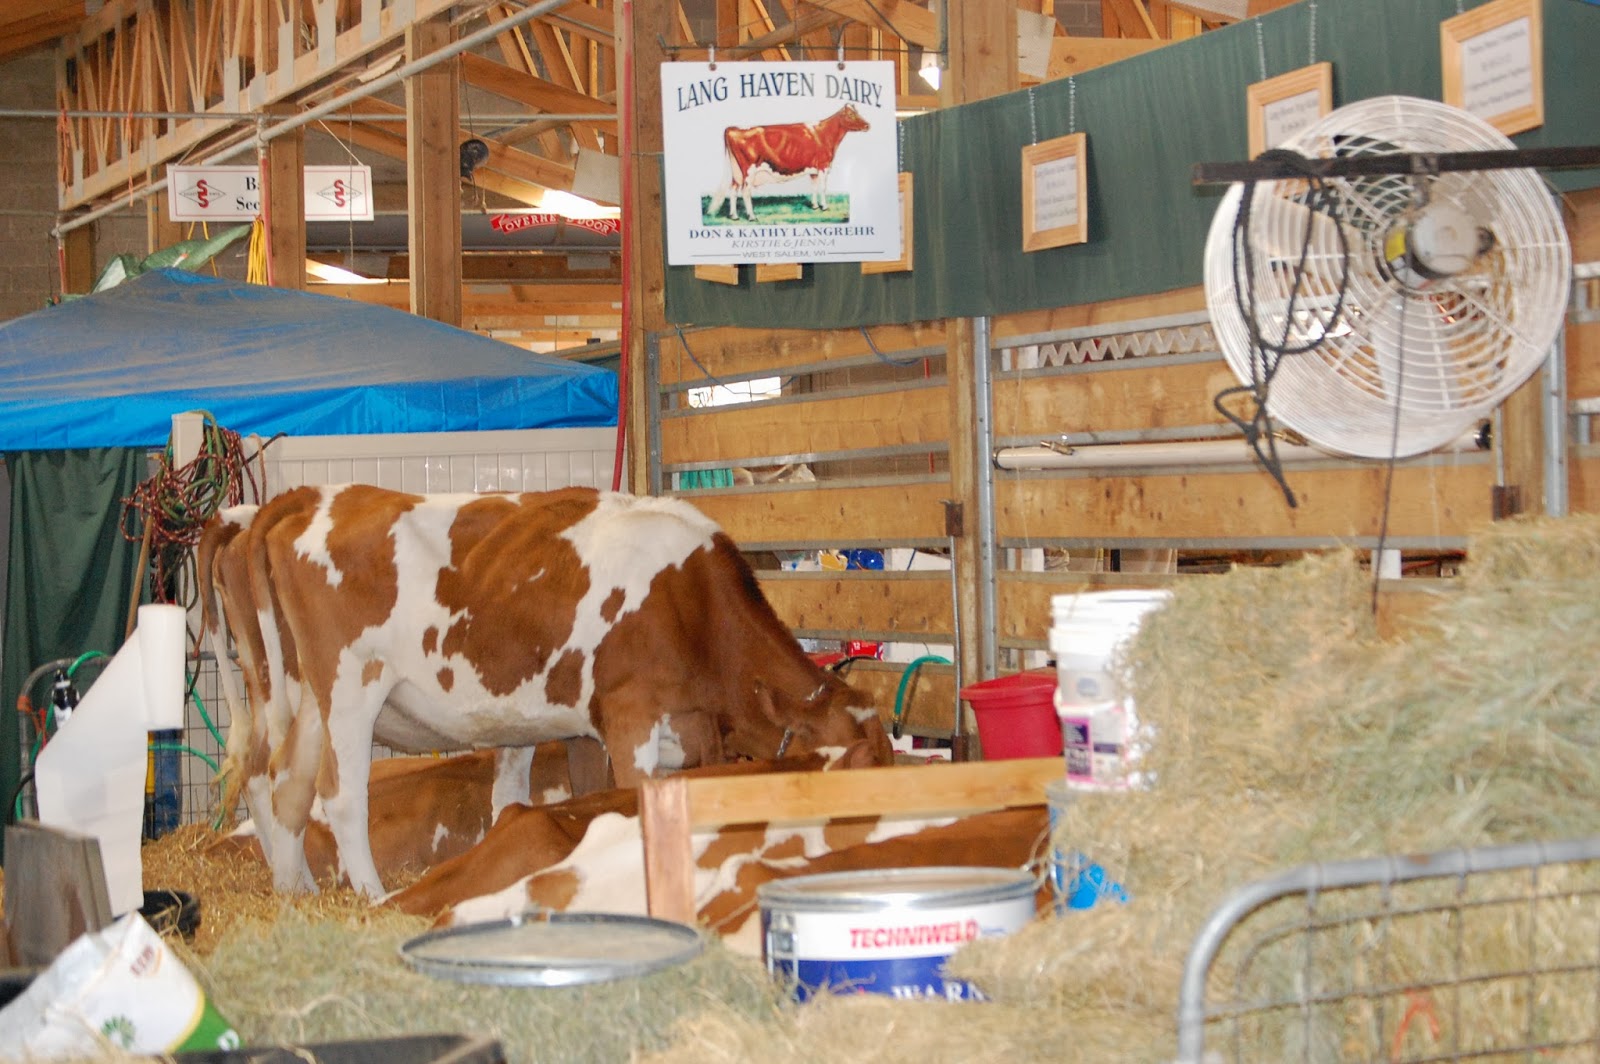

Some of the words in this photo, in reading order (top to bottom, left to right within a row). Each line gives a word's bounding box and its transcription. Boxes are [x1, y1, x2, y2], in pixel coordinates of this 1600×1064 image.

[678, 77, 728, 112] LANG
[740, 72, 815, 98] HAVEN
[826, 74, 883, 108] DAIRY
[577, 218, 610, 234] DOOR
[689, 229, 722, 239] DON
[725, 228, 734, 238] &
[739, 228, 789, 238] KATHY
[792, 226, 875, 237] LANGREHR
[731, 239, 782, 249] KIRSTIE
[792, 238, 837, 249] JENNA
[850, 919, 978, 948] TECHNIWELD
